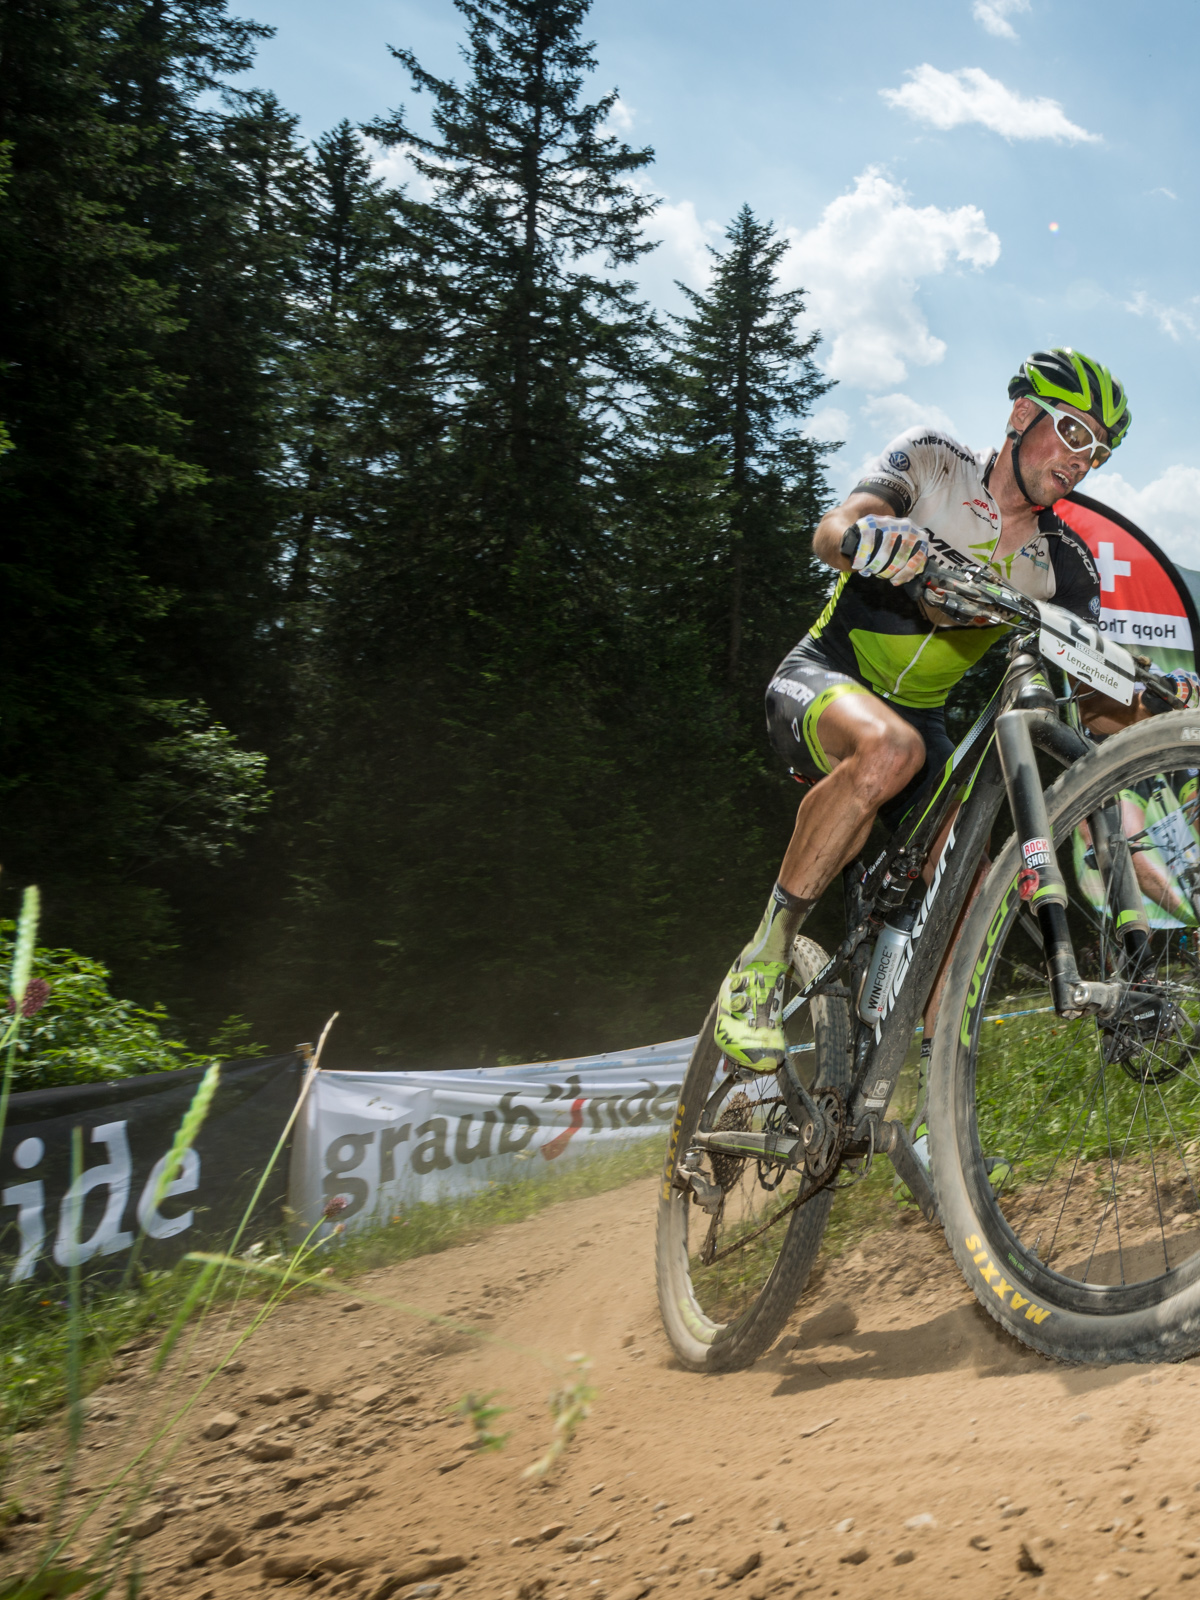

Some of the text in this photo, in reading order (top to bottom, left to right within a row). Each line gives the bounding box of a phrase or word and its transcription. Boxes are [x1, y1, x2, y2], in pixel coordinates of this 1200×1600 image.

[972, 498, 998, 520] SRM
[1058, 529, 1099, 584] ERIDA
[768, 676, 816, 706] MERIDA
[1066, 651, 1119, 690] Lenzerheide
[1024, 840, 1048, 856] ROCK
[1026, 853, 1050, 869] SHOX
[959, 870, 1021, 1047] FULCR
[662, 1103, 686, 1201] MAXXIS
[3, 1120, 201, 1285] ide
[965, 1233, 1052, 1325] MAXXIS
